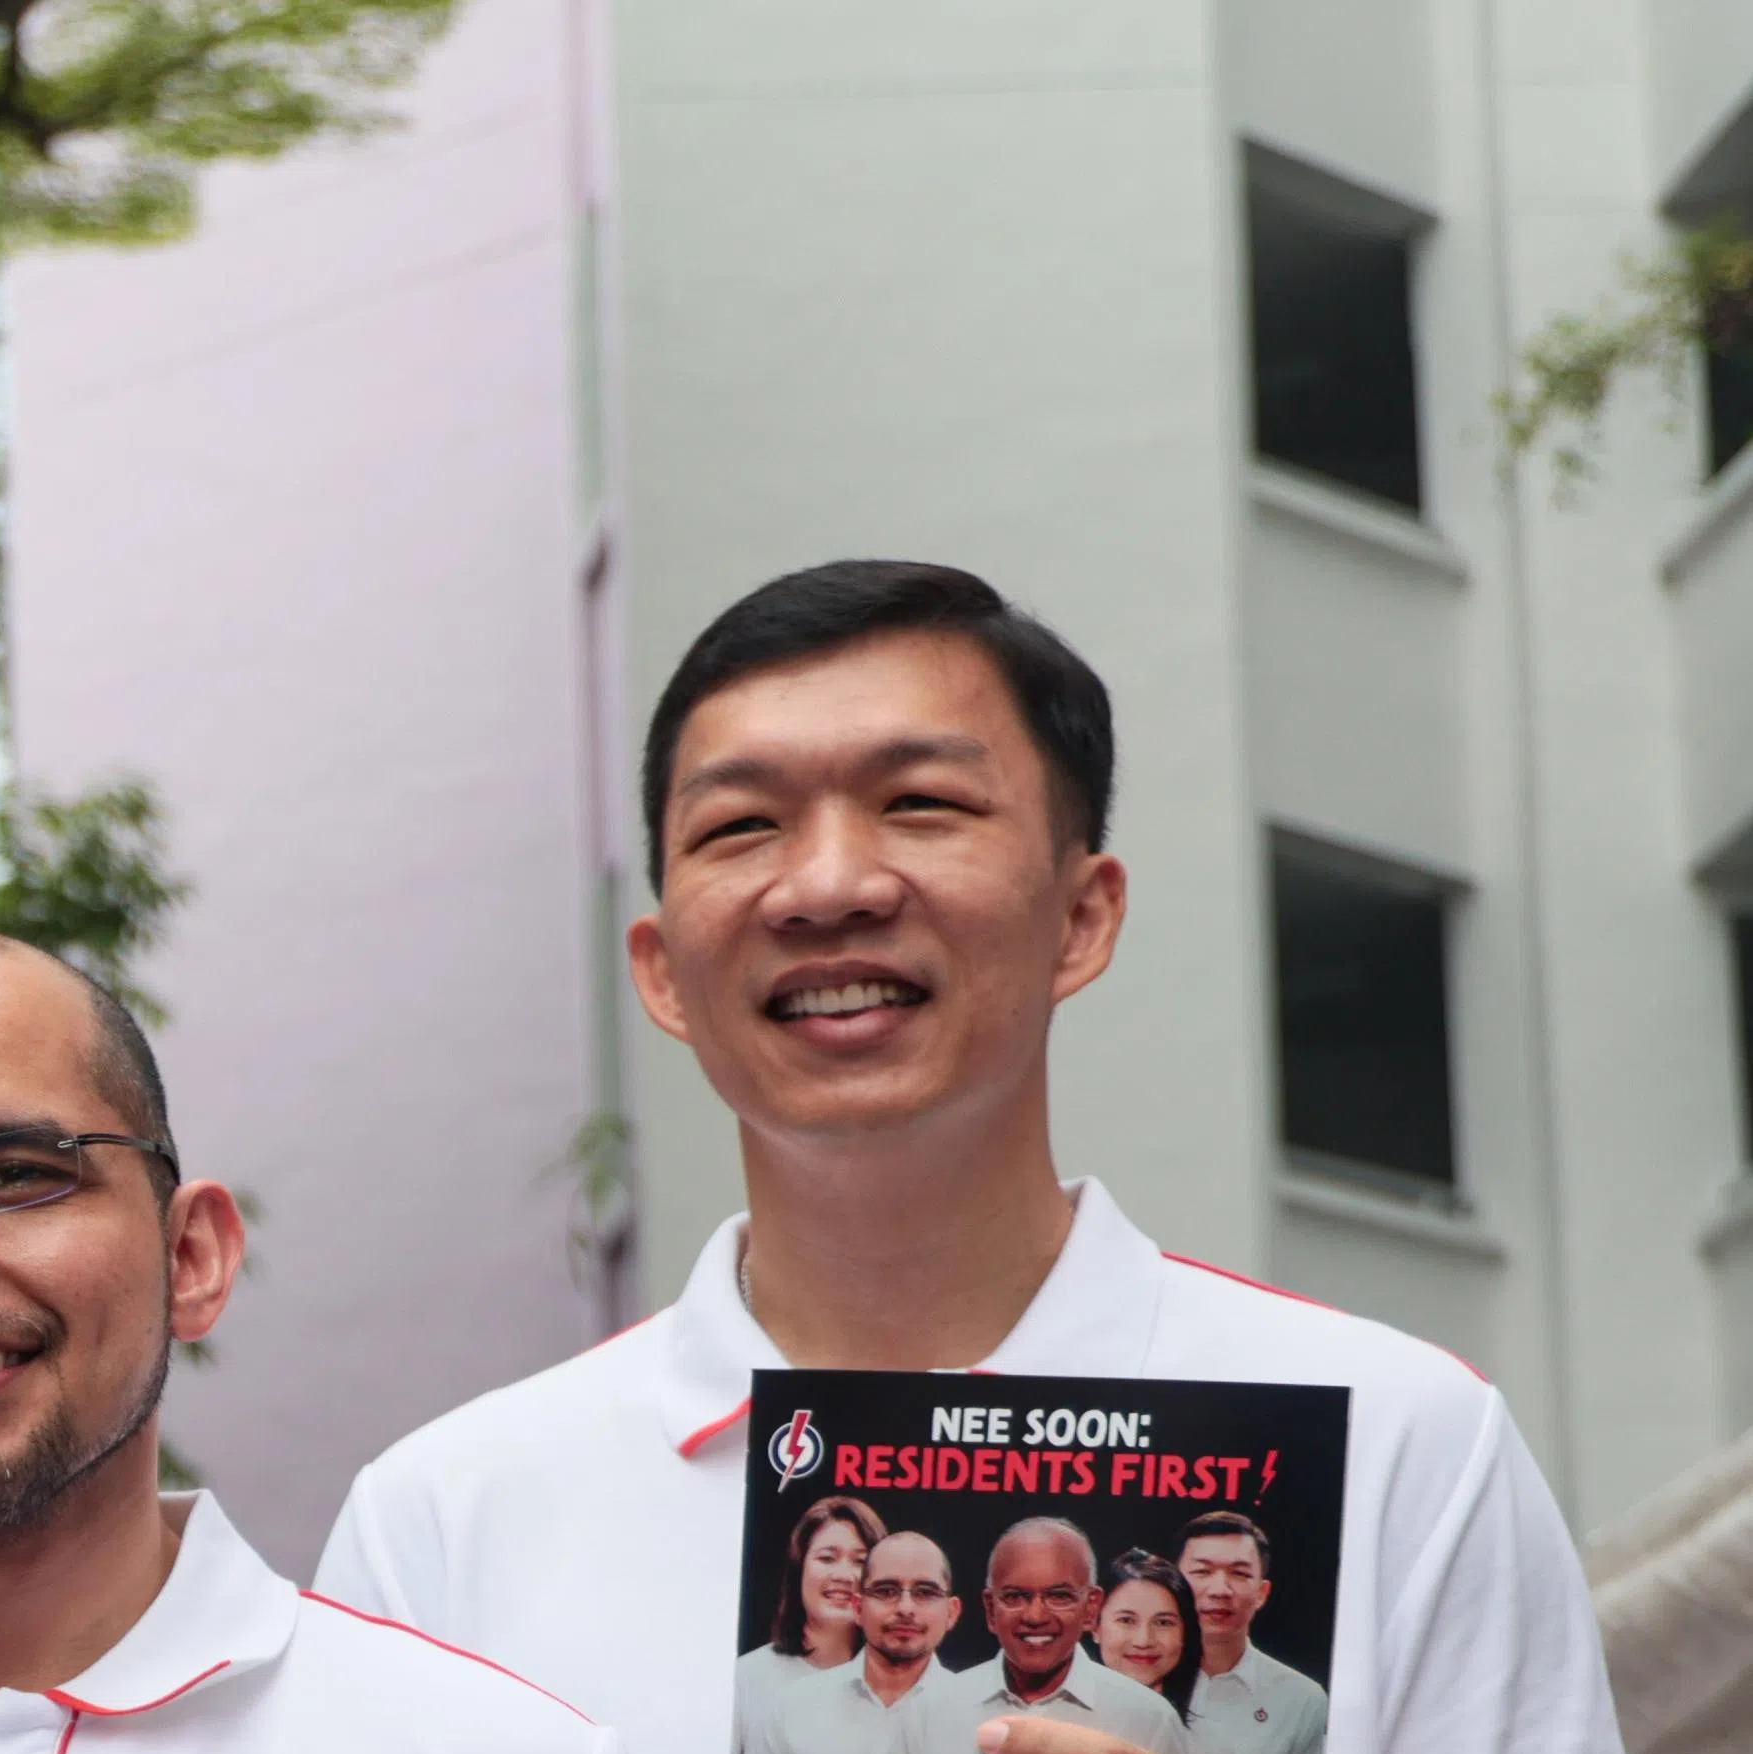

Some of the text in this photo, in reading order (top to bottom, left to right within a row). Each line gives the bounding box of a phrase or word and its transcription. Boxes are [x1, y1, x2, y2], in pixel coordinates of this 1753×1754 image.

[931, 1406, 1152, 1448] NEE SOON:
[833, 1442, 1098, 1496] RESIDENTS
